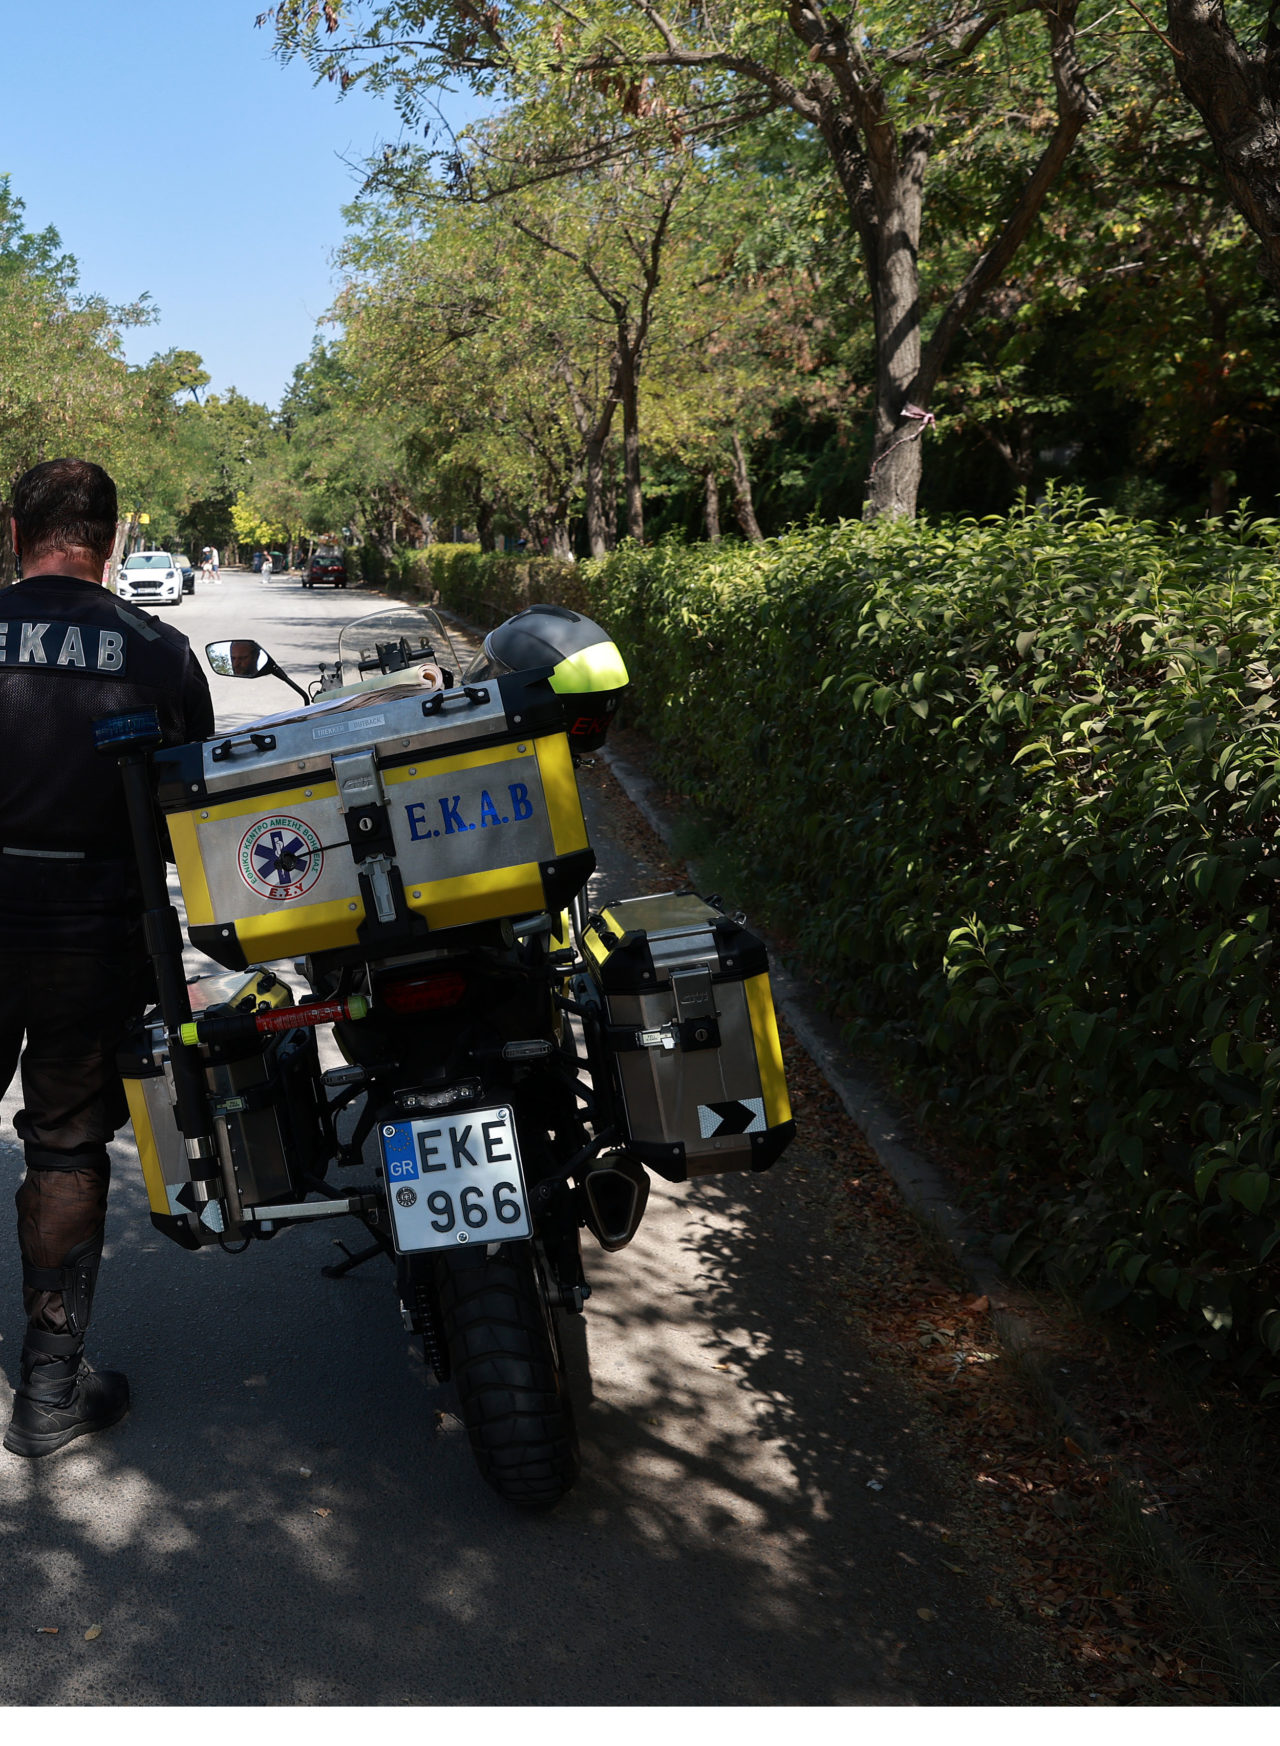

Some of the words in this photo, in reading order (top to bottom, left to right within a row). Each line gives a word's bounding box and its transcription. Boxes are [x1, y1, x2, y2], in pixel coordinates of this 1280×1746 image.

[243, 822, 269, 850] ΚΕΝΤΡΟ
[269, 818, 303, 832] ΑΜΕΣΗΣ
[390, 1160, 415, 1177] GR
[417, 1120, 513, 1174] EKE
[427, 1181, 521, 1233] 966
